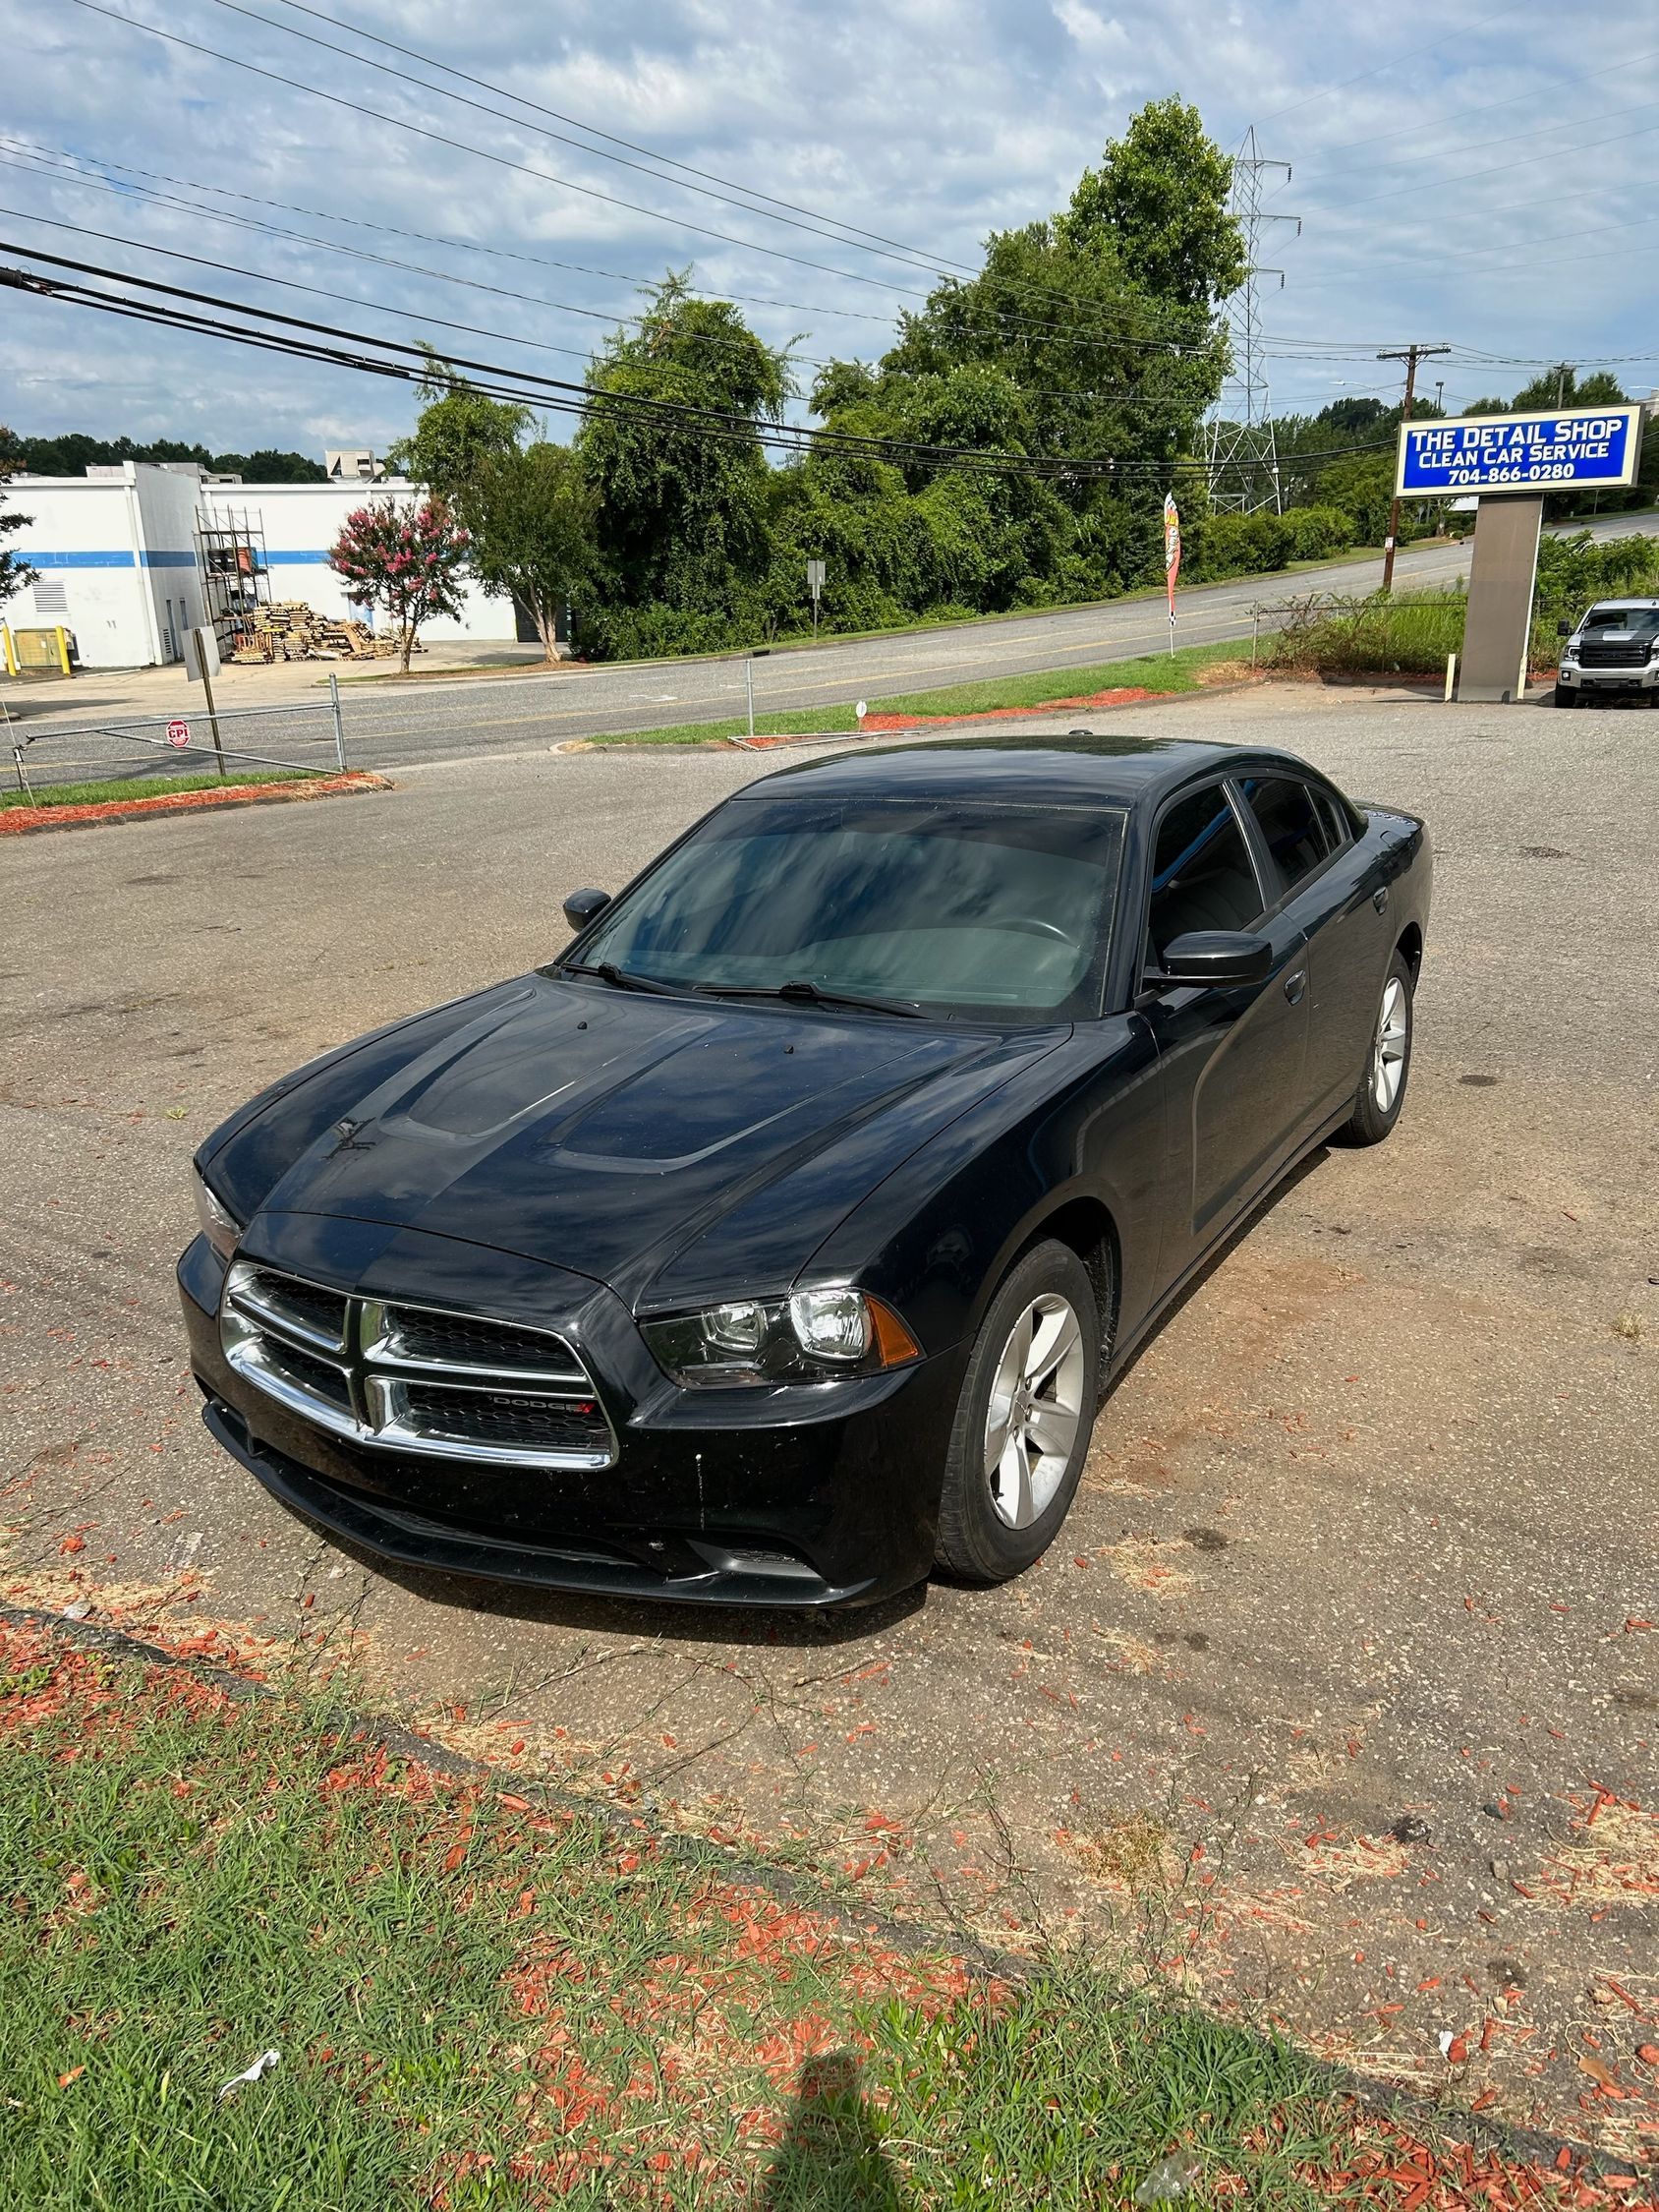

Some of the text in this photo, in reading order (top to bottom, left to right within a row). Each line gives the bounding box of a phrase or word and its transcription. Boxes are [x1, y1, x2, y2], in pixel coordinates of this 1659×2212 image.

[1412, 419, 1622, 451] THE DETAIL SHOP
[1418, 442, 1609, 469] CLEAN CAR SERVICE
[1448, 463, 1574, 485] 704-866-0280
[168, 728, 189, 738] CPI
[493, 1397, 582, 1412] DODGE
